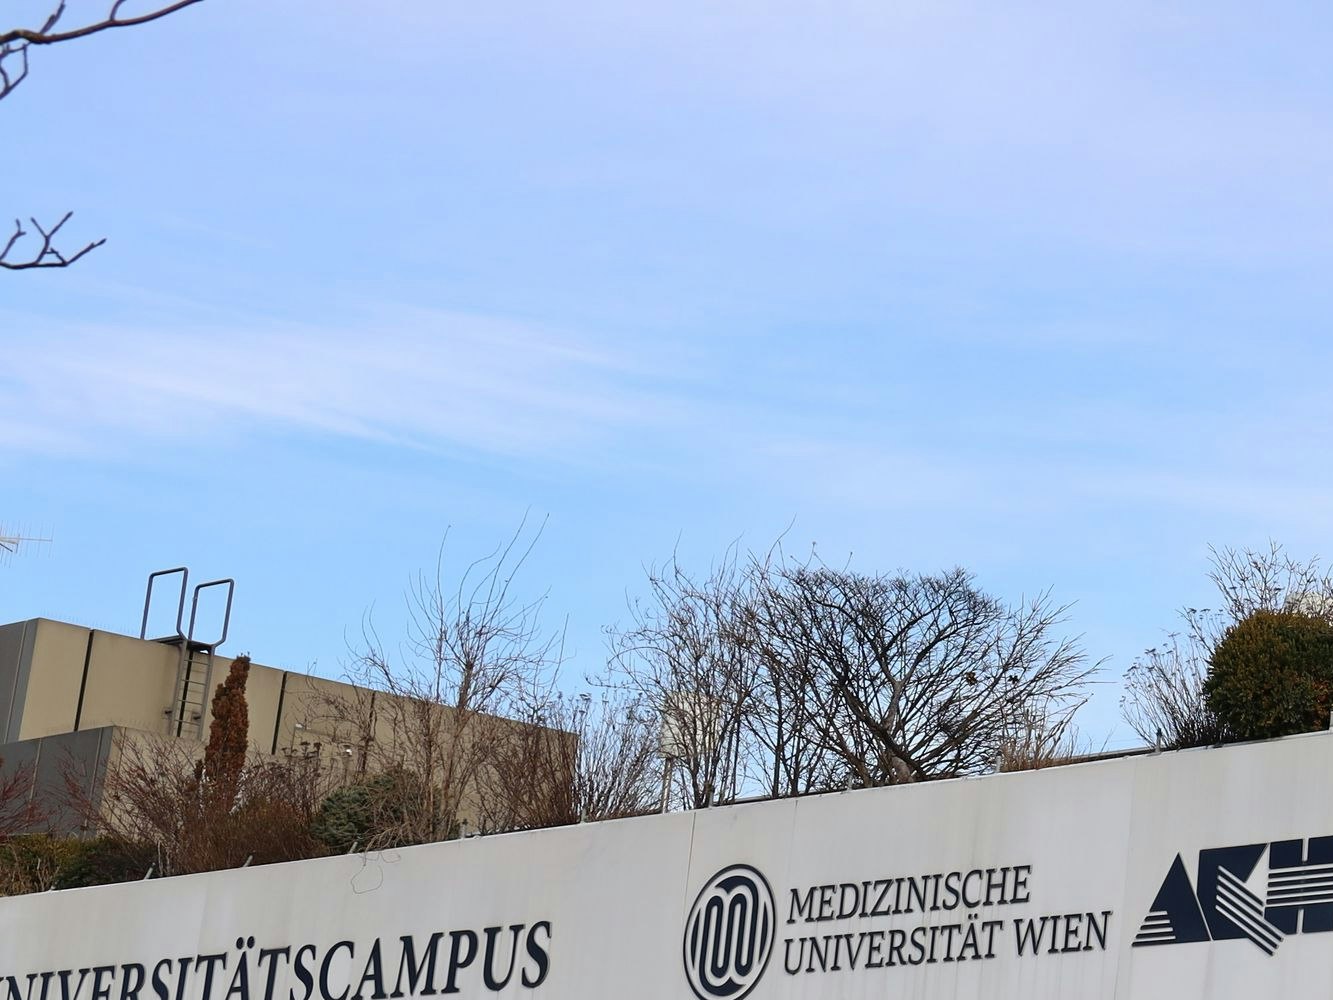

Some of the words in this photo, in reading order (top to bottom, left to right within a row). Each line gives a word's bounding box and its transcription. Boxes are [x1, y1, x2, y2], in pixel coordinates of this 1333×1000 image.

[786, 865, 1031, 924] MEDIZINISCHE
[783, 913, 1004, 975] UNIVERSITÄT
[1013, 911, 1112, 957] WIEN
